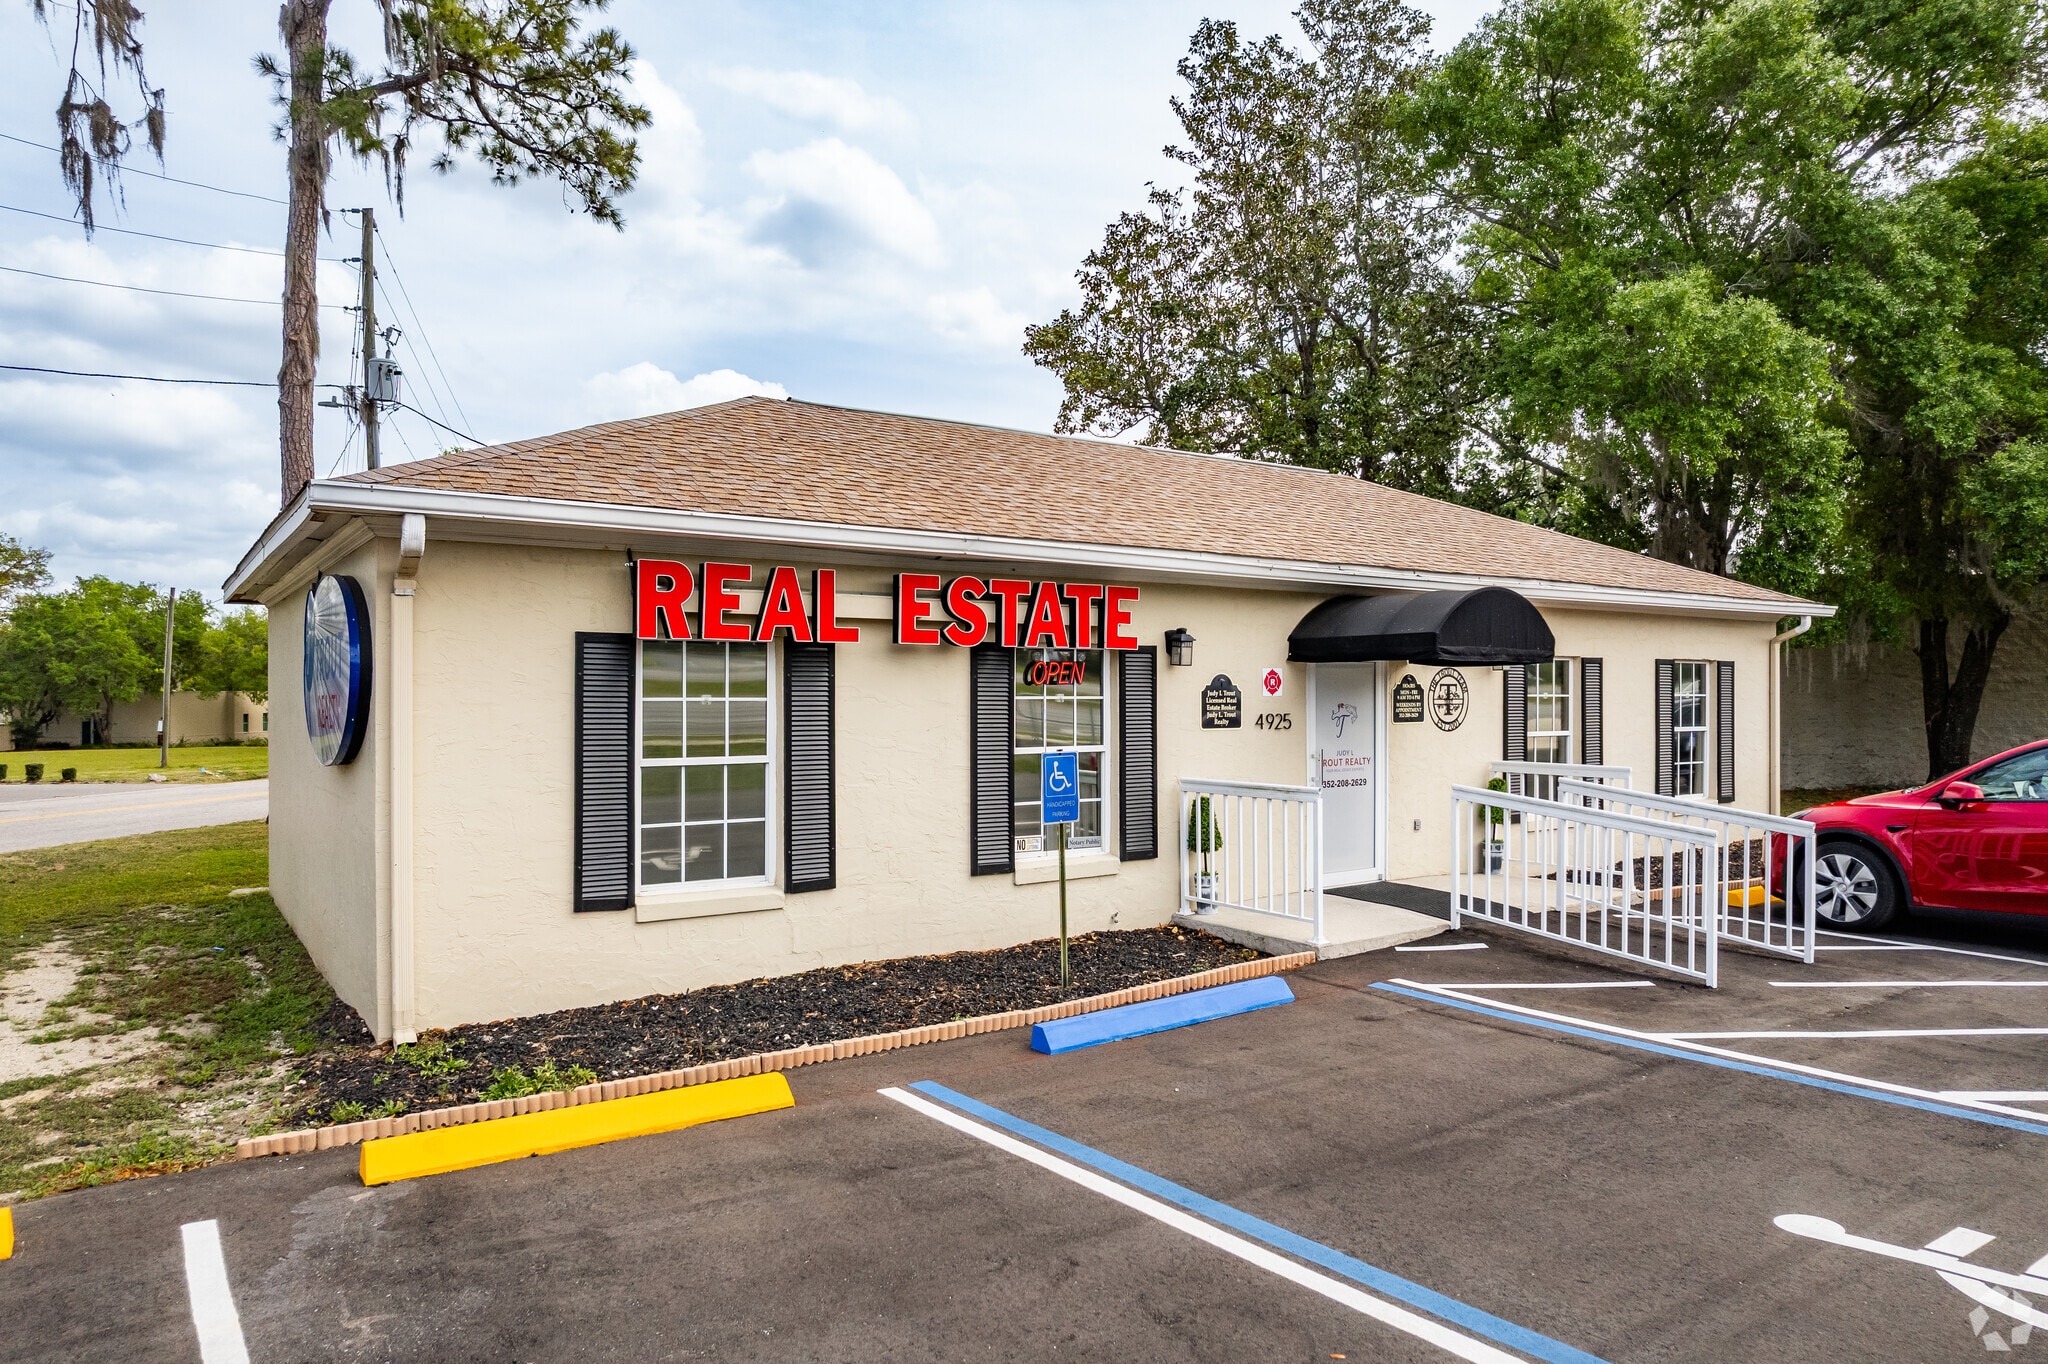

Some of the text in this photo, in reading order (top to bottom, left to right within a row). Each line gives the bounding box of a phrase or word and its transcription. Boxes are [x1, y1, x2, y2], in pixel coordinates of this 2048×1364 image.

[636, 559, 1140, 650] REAL ESTATE
[1031, 660, 1087, 686] OPEN
[1206, 711, 1218, 719] Judy
[1214, 718, 1229, 726] Realty
[1255, 713, 1292, 730] 4925
[1345, 757, 1371, 766] REALTY
[1322, 778, 1367, 788] 352-208-2629
[1046, 800, 1076, 808] HANDICAPPED
[1016, 839, 1026, 851] NO
[1069, 837, 1101, 847] Notary Public
